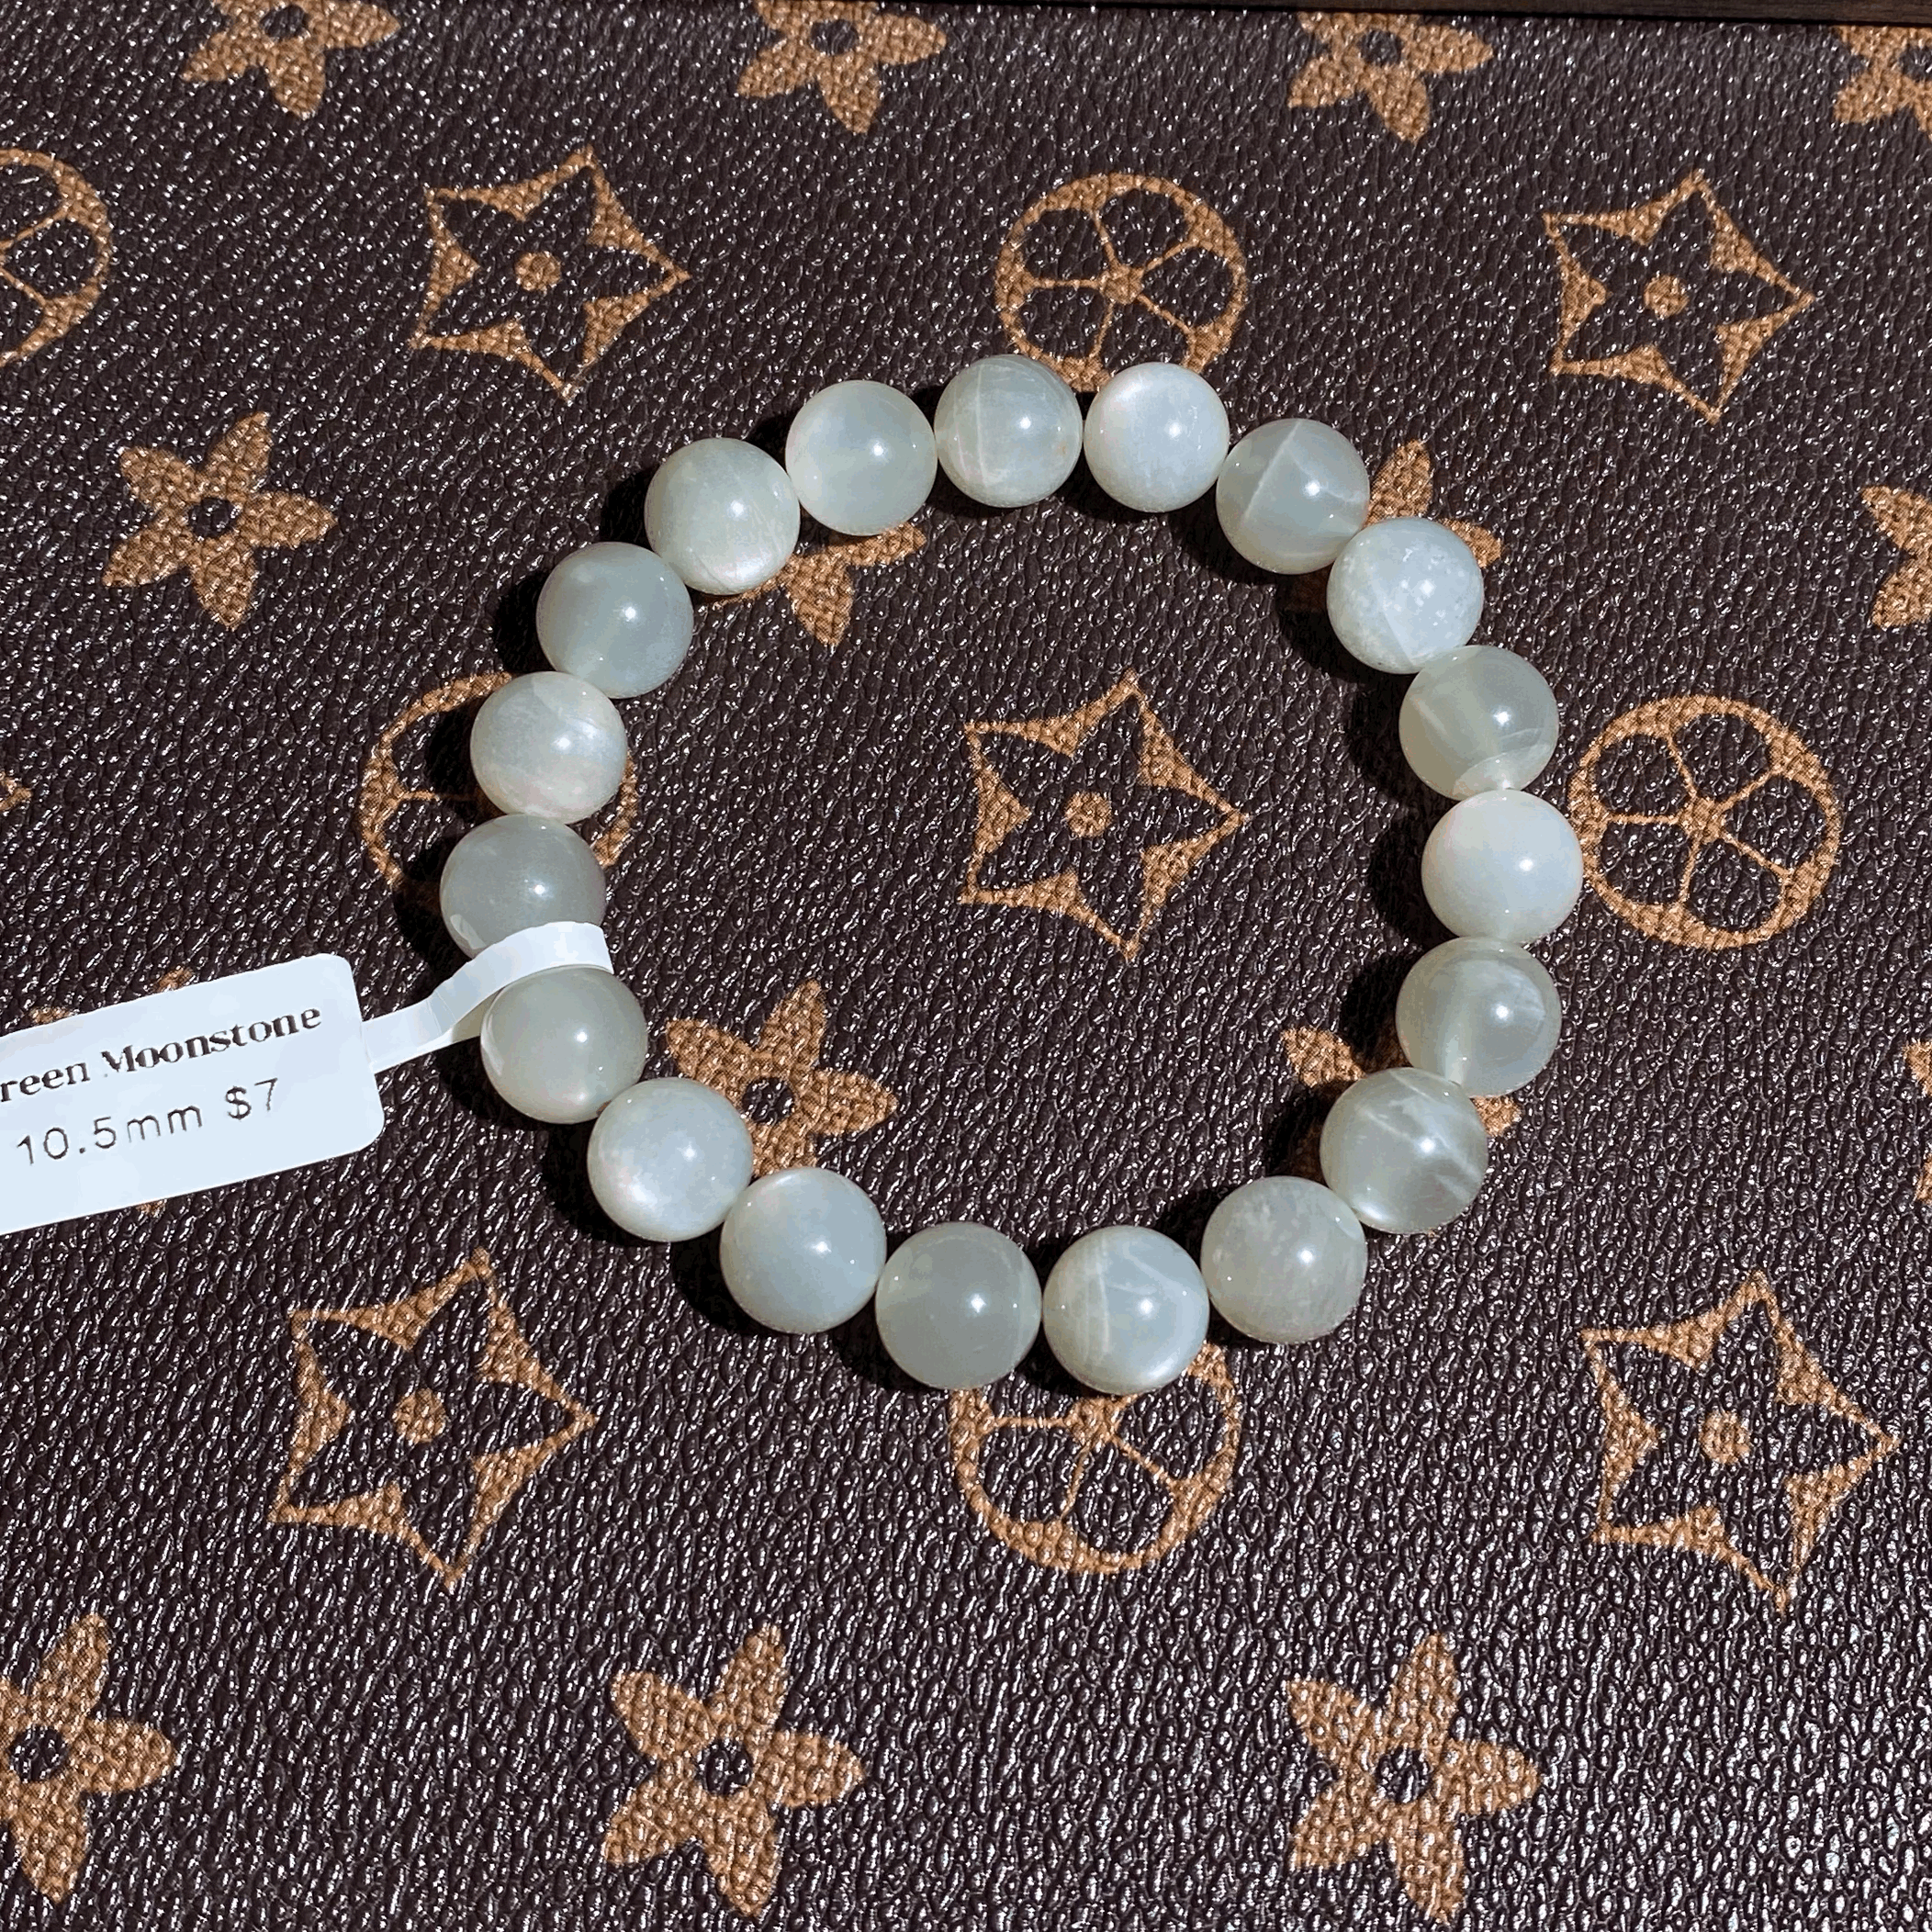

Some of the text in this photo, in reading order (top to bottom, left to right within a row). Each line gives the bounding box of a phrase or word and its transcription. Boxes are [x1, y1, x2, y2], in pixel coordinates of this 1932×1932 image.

[0, 1006, 322, 1103] reen Moonstone
[16, 1076, 279, 1165] 10.5mm $7
